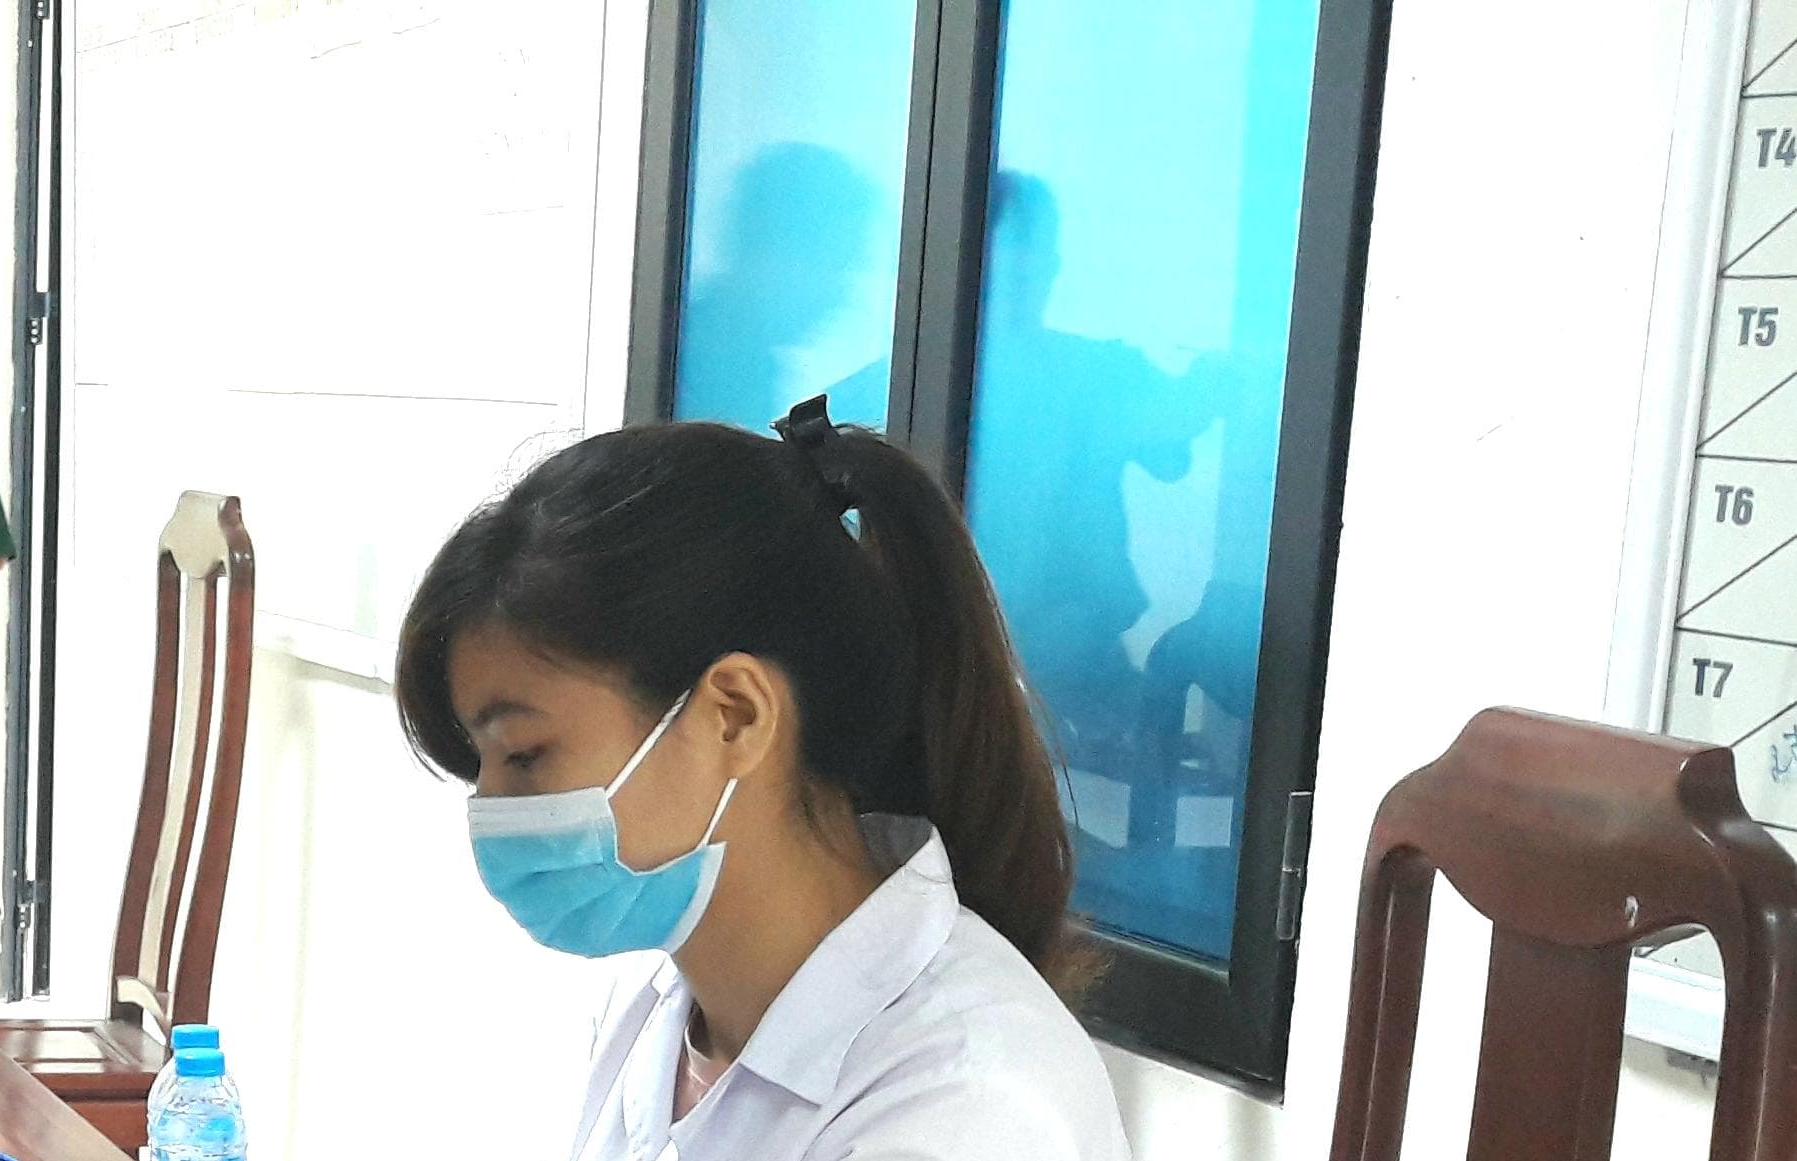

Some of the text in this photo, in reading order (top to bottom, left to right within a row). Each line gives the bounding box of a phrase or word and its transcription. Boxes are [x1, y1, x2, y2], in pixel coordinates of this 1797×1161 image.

[1756, 127, 1797, 168] T4
[1737, 306, 1779, 347] T5
[1714, 484, 1754, 526] T6
[1692, 658, 1734, 699] T7
